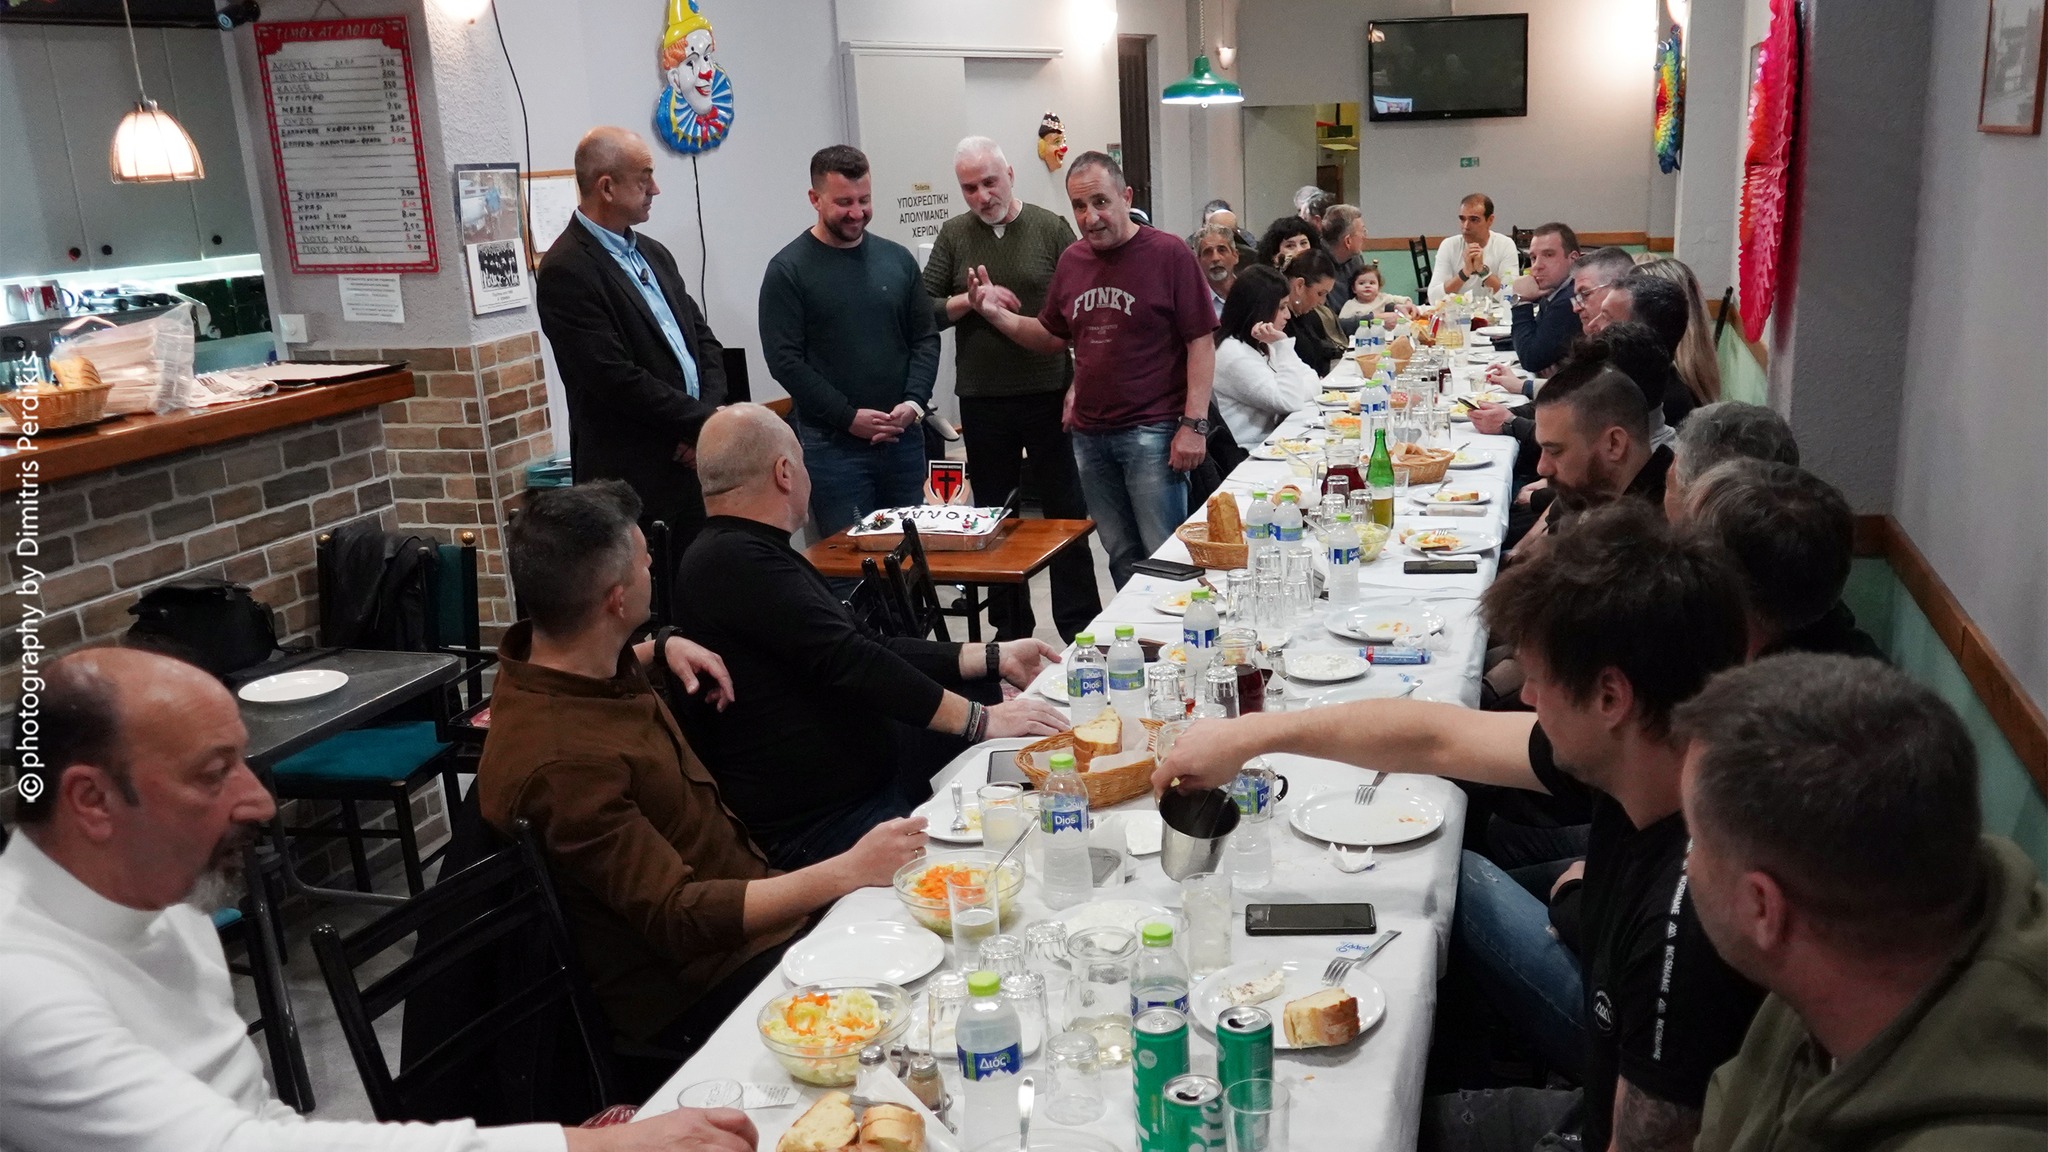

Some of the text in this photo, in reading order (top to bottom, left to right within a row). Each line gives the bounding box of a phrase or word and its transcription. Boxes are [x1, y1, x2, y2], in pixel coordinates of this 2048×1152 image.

[897, 194, 949, 208] ΥΠΟΧΡΕΩΤΙΚΗ
[899, 208, 949, 224] ΑΠΟΛΥΜΑΝΣΗ
[912, 225, 939, 238] ΧΕΡΙΩΝ
[1072, 287, 1136, 320] FUNKY
[1083, 682, 1100, 690] Dios
[1055, 815, 1076, 825] Dios
[1671, 875, 1688, 915] NOSHAME
[1660, 945, 1675, 993] NOSHAME
[980, 1056, 1007, 1069] Διός
